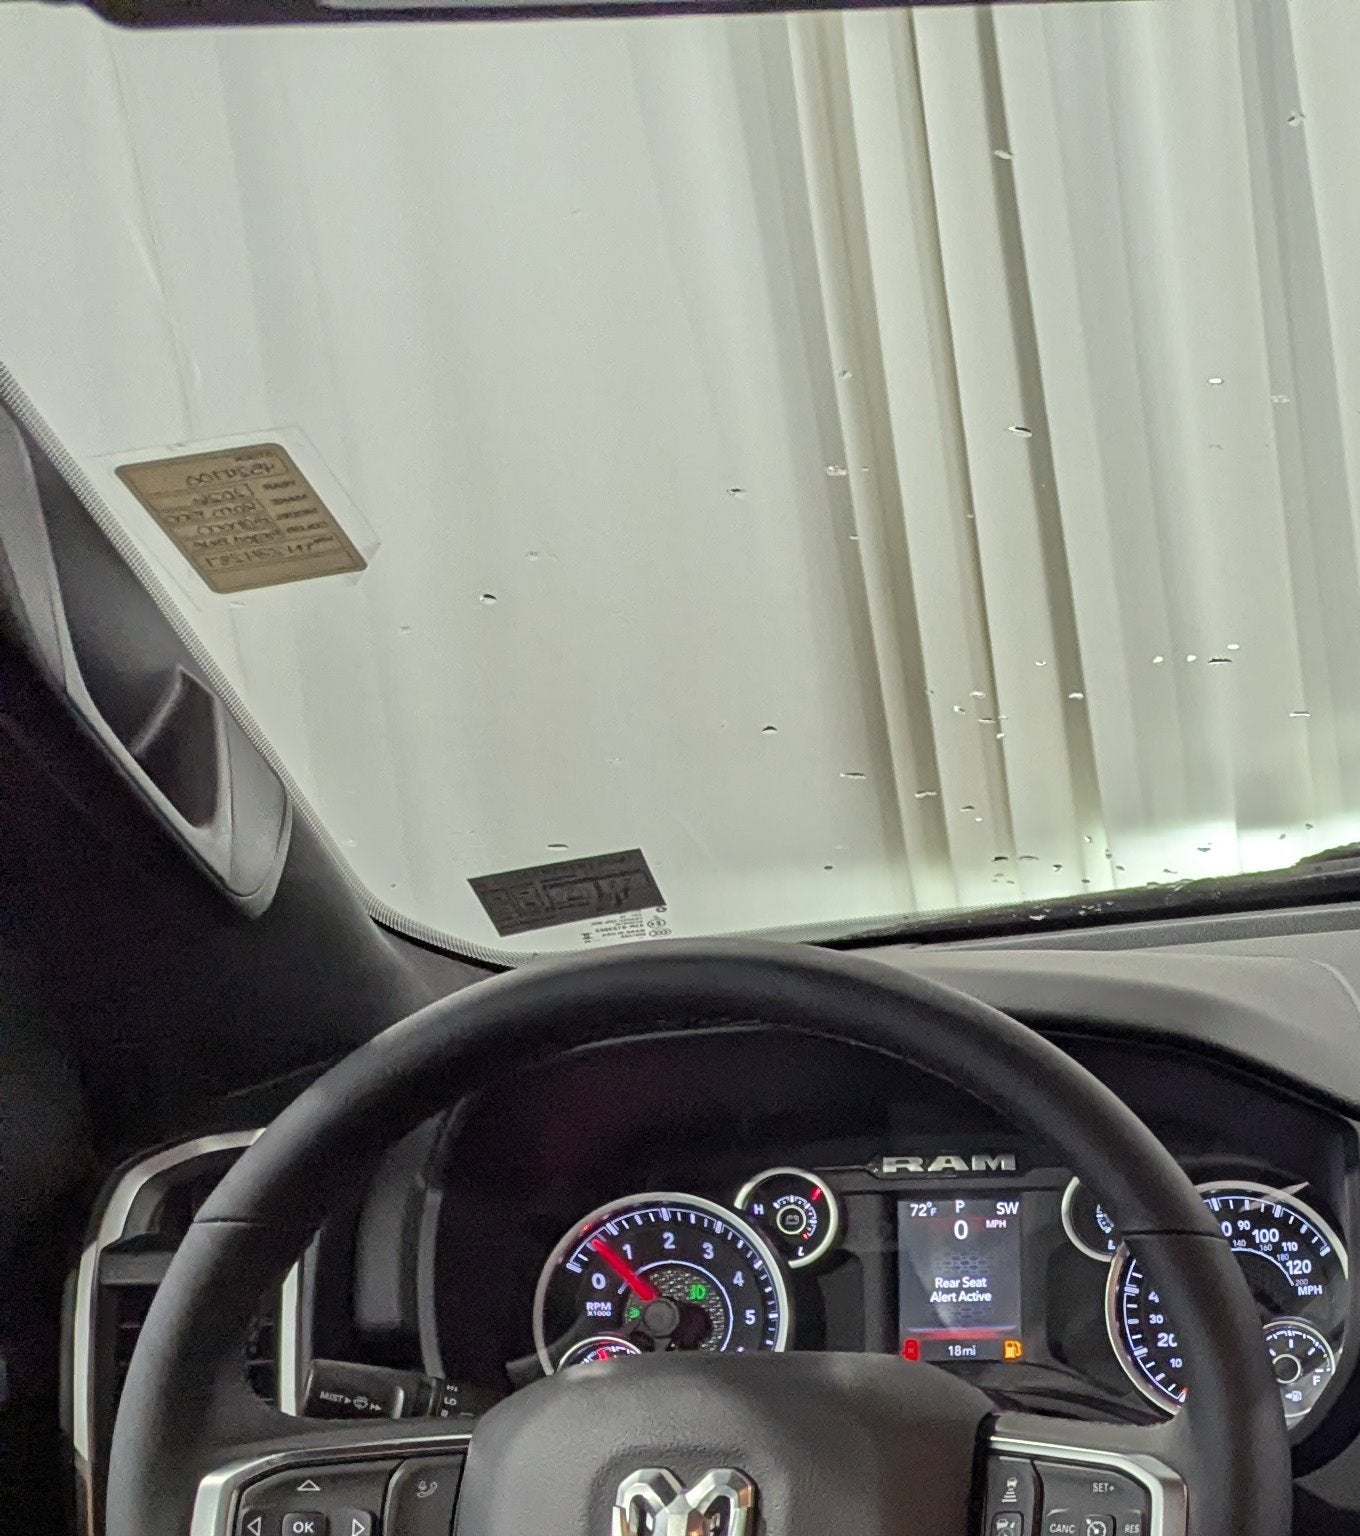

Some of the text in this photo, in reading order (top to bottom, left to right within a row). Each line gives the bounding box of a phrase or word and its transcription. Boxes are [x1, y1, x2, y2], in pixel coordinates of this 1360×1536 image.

[882, 1154, 1016, 1173] RAM
[753, 1204, 764, 1215] H
[955, 1200, 965, 1213] P
[996, 1201, 1019, 1215] SW
[953, 1219, 968, 1240] 0
[986, 1219, 1007, 1229] MPH
[1237, 1220, 1250, 1231] 90
[663, 1232, 676, 1249] 2
[1252, 1228, 1280, 1243] 100
[623, 1244, 632, 1260] 1
[703, 1242, 714, 1260] 3
[1282, 1241, 1298, 1252] 110
[1286, 1260, 1312, 1275] 120
[591, 1273, 607, 1290] 0
[732, 1271, 744, 1287] 4
[934, 1277, 987, 1288] Rear Seat
[930, 1290, 992, 1303] Alert Active
[1298, 1285, 1322, 1296] MPH
[586, 1302, 612, 1311] RPM
[745, 1309, 756, 1325] 5
[1149, 1314, 1164, 1324] 30
[1170, 1358, 1183, 1368] 10
[1313, 1376, 1321, 1386] F
[320, 1391, 344, 1403] MIST
[444, 1397, 457, 1406] LO
[292, 1521, 314, 1534] OK
[1050, 1523, 1075, 1535] CANC
[1124, 1524, 1140, 1534] RES
